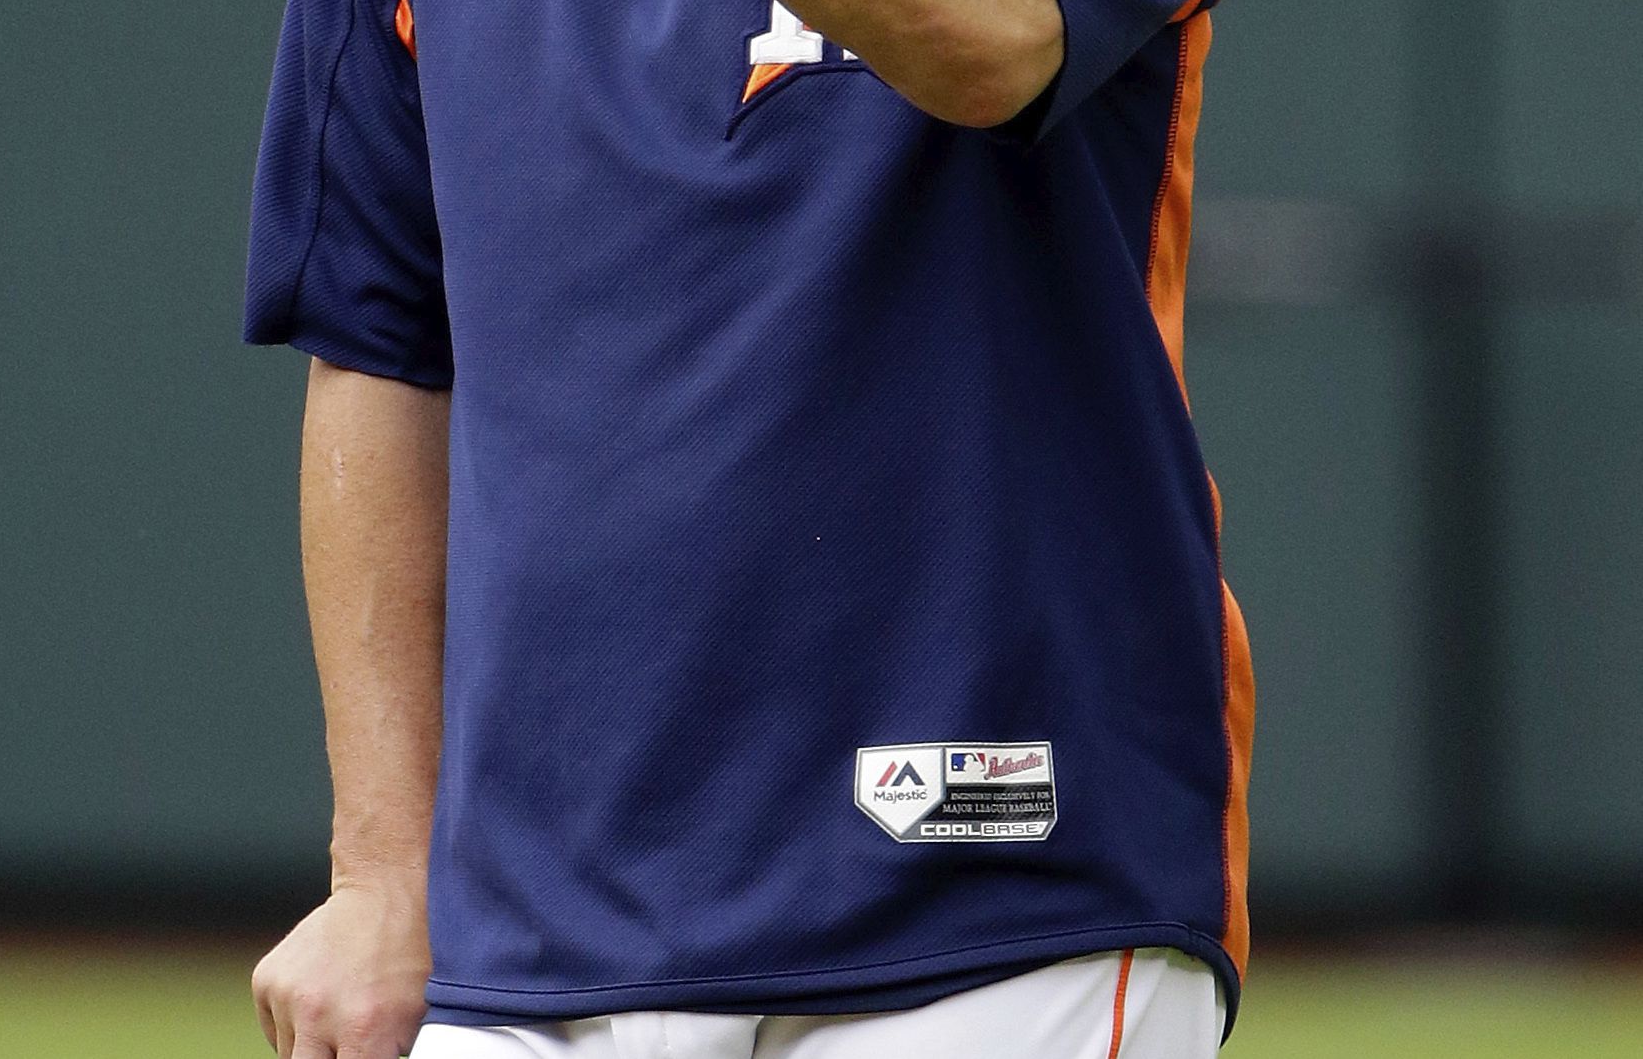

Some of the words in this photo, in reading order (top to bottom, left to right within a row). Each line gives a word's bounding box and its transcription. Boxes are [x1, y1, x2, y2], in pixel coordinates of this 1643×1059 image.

[873, 788, 928, 804] Majestic
[942, 803, 973, 814] MAJOR
[975, 803, 1007, 813] LEAGUE
